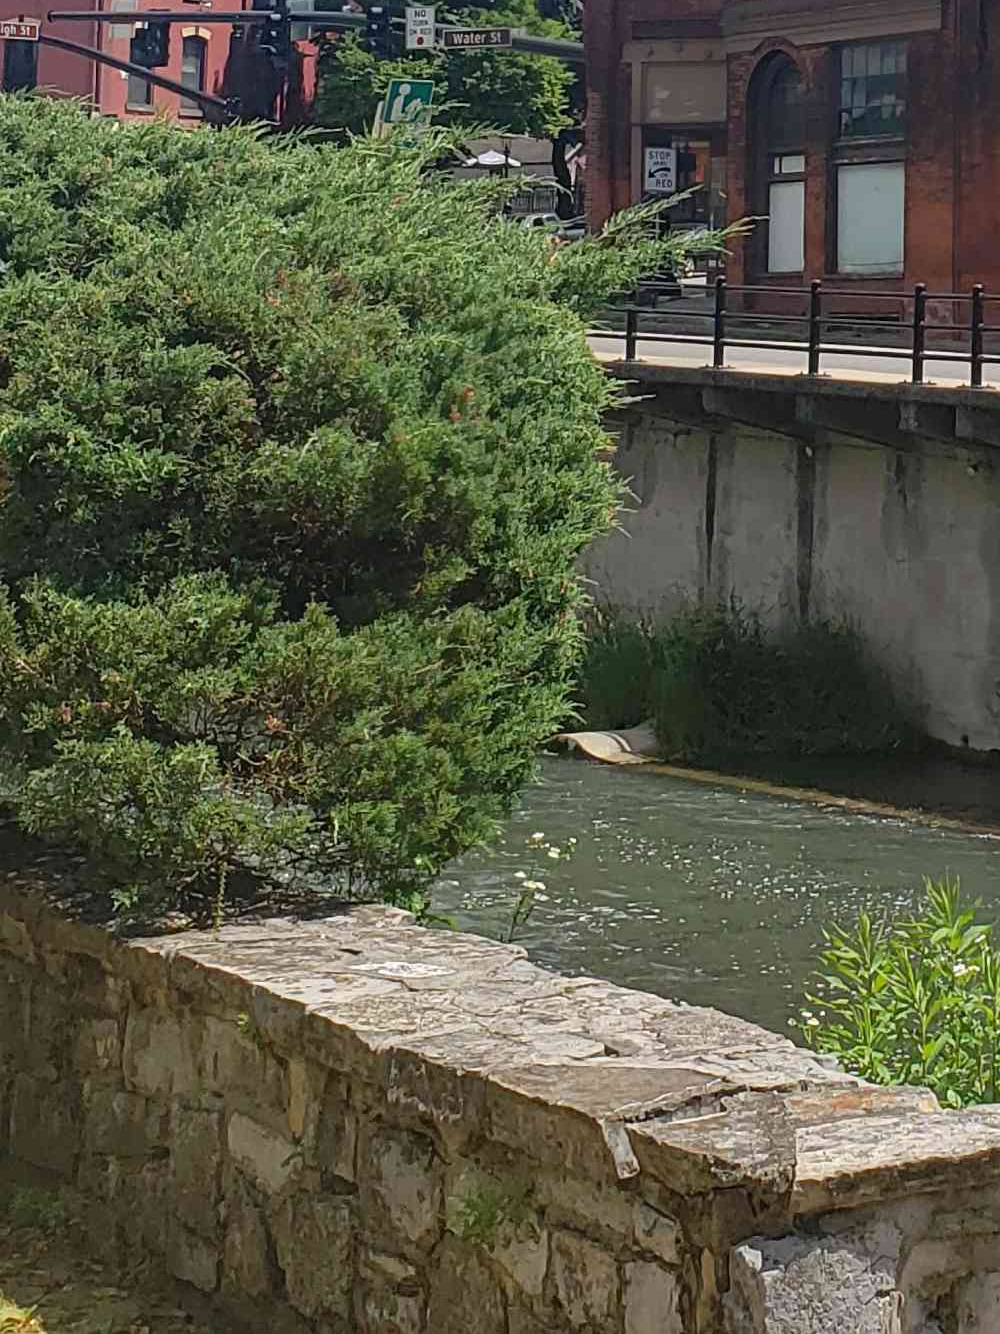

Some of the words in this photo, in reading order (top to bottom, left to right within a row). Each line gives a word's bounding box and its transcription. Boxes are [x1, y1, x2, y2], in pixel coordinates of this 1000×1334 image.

[414, 9, 426, 18] NO
[20, 25, 31, 36] St
[452, 33, 487, 45] Water
[490, 31, 502, 43] St
[648, 150, 671, 160] STOP
[656, 178, 673, 188] RED
